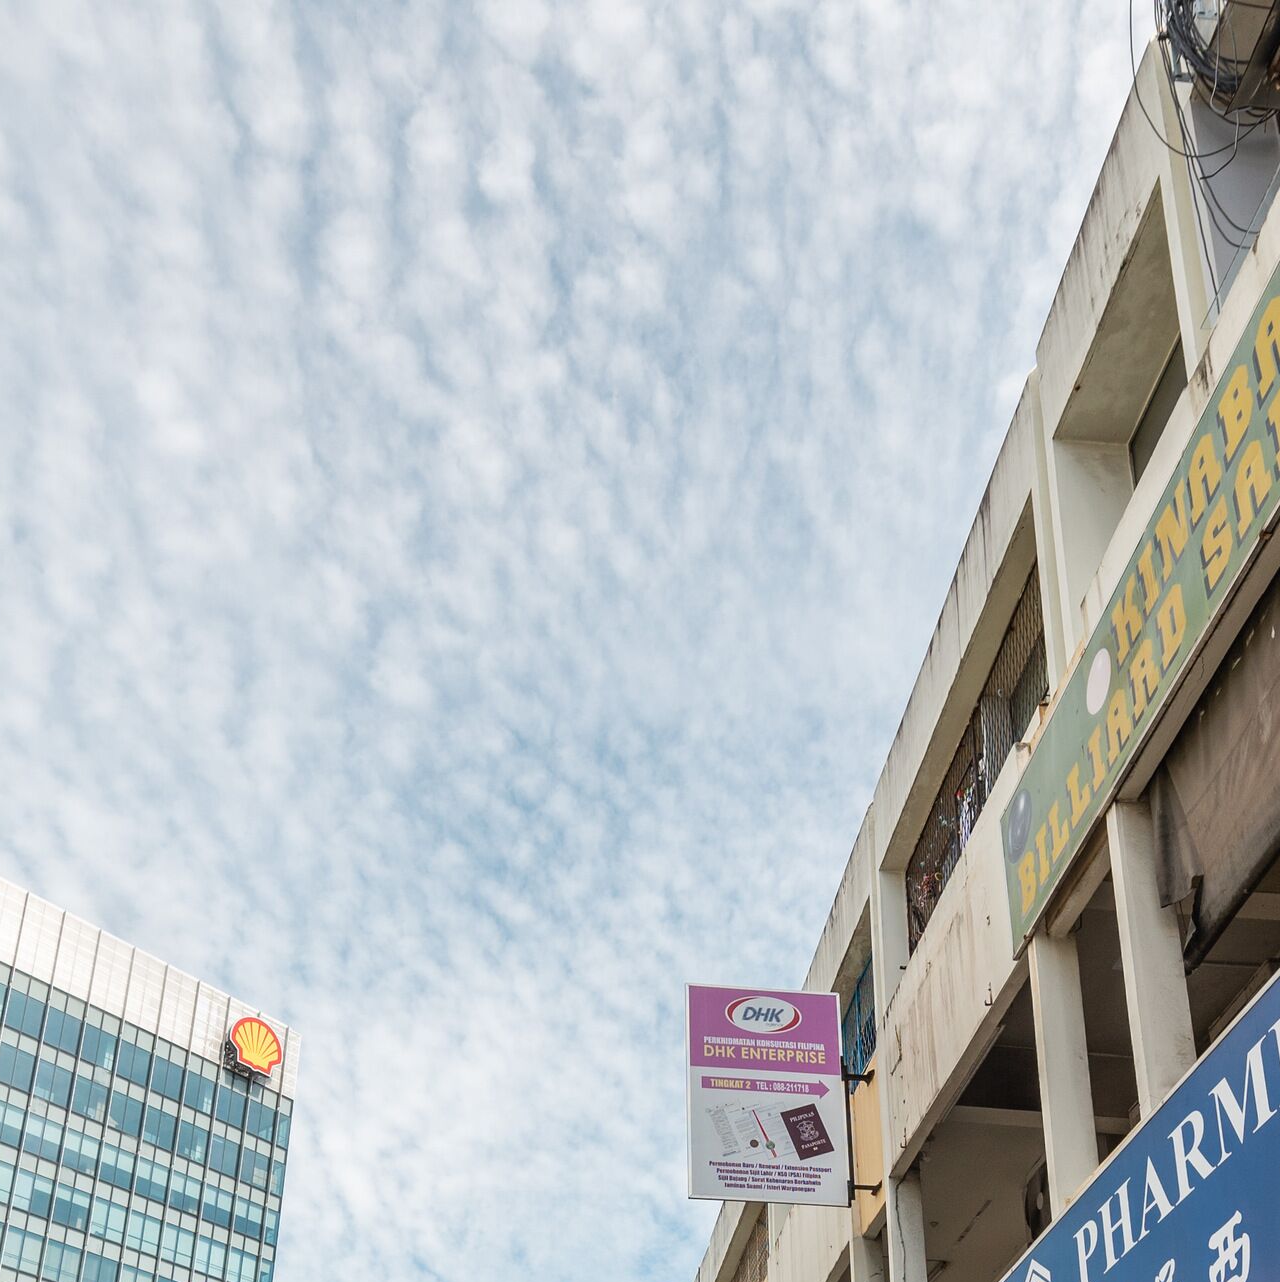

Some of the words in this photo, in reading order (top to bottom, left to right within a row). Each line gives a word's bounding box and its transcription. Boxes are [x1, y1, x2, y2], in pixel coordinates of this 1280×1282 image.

[1019, 584, 1186, 921] BILLIARD
[742, 1006, 784, 1023] DHK
[704, 1045, 736, 1058] DHK
[741, 1048, 826, 1064] ENTERPRISE
[710, 1078, 744, 1089] TINGKAT
[745, 1081, 751, 1089] 2
